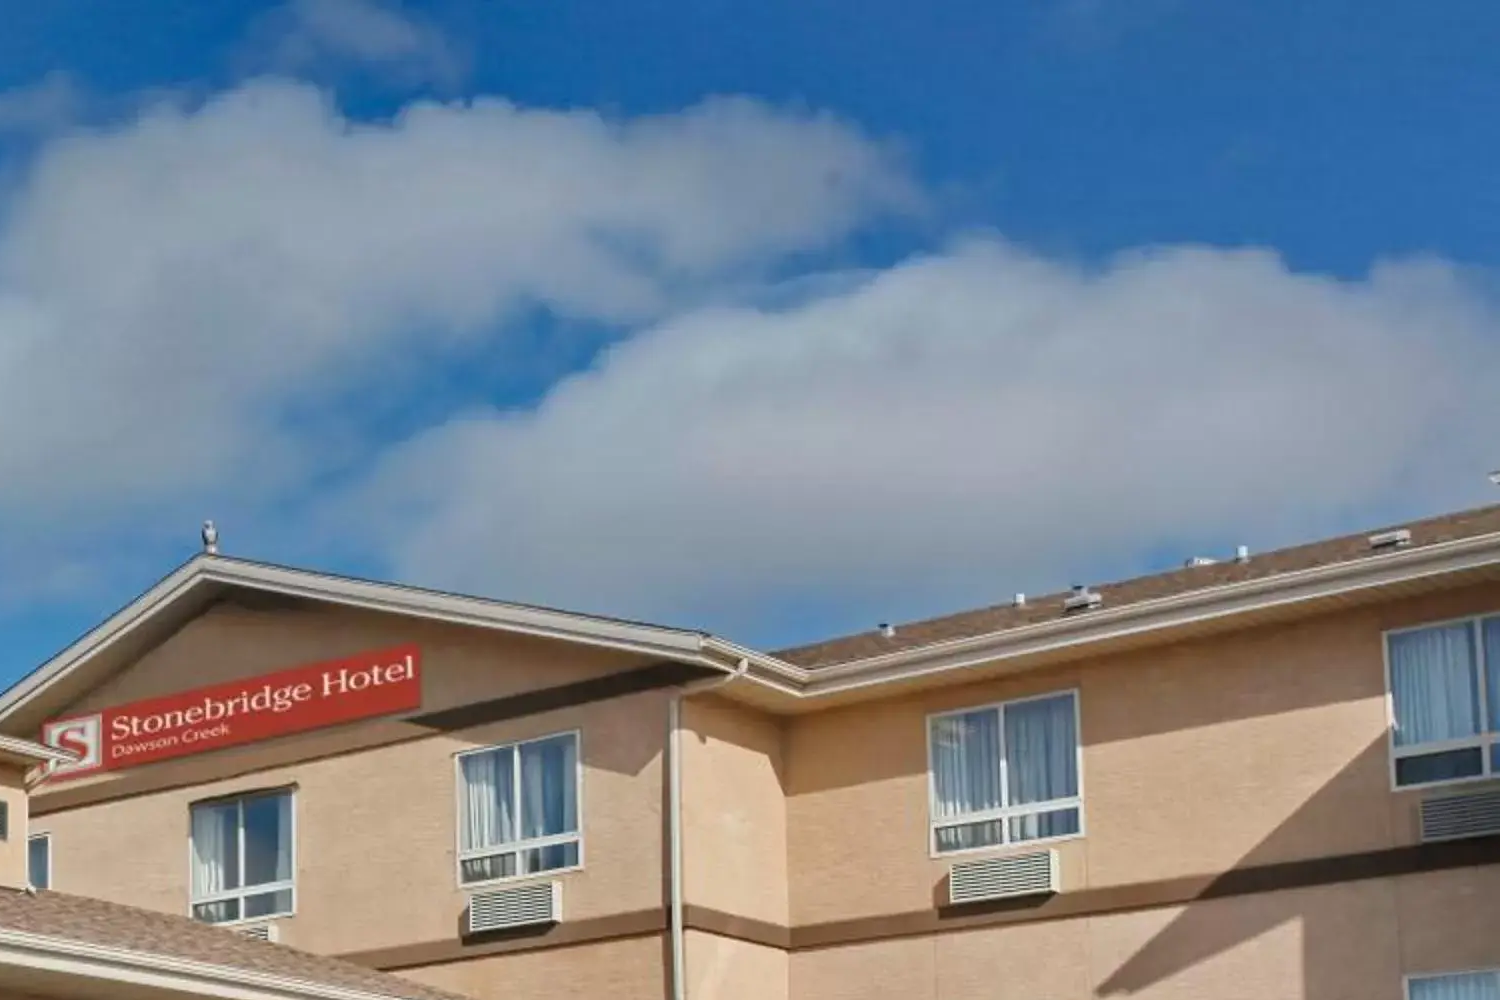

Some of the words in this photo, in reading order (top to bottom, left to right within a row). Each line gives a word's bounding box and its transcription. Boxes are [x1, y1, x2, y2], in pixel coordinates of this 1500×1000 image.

[111, 683, 312, 742] Stonebridge
[321, 654, 414, 697] Hotel
[111, 736, 178, 759] Dawson
[181, 723, 231, 744] Creek
